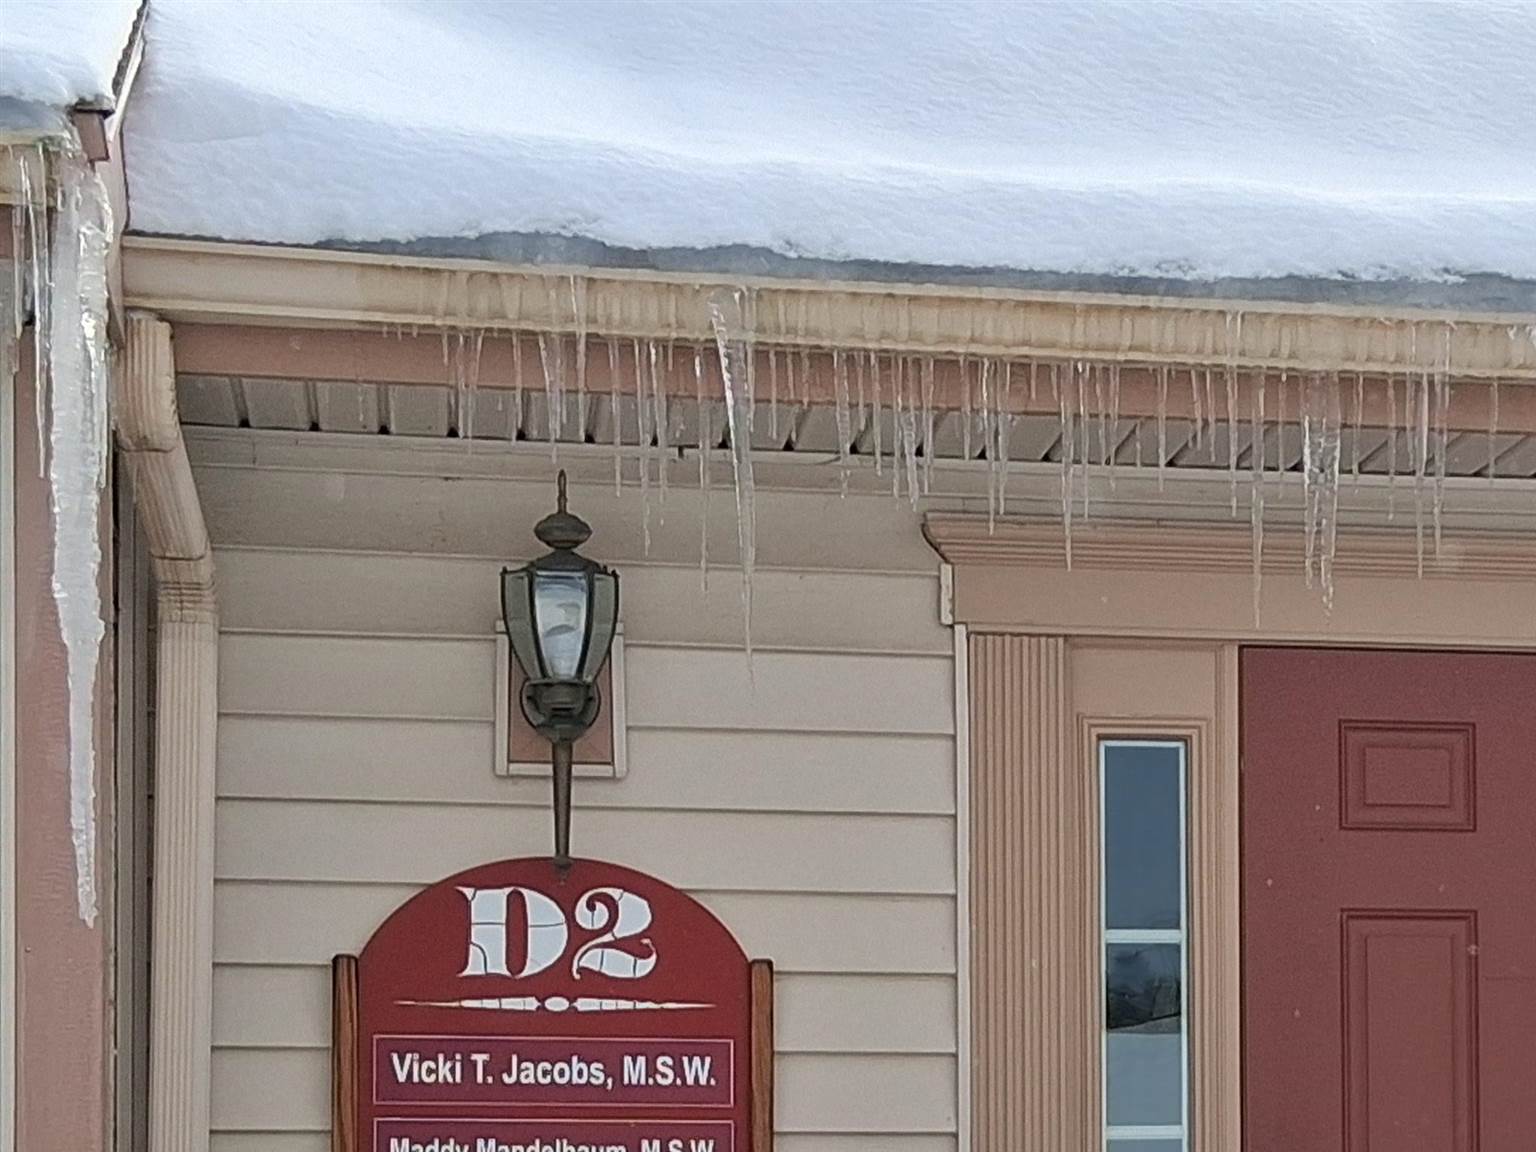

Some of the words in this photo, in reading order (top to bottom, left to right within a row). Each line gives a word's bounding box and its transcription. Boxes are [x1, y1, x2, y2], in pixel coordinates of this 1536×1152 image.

[455, 886, 657, 980] D2
[390, 1053, 462, 1084] Vicki
[470, 1053, 493, 1085] T.
[502, 1055, 613, 1090] Jacobs,
[623, 1056, 716, 1087] M.S.W.
